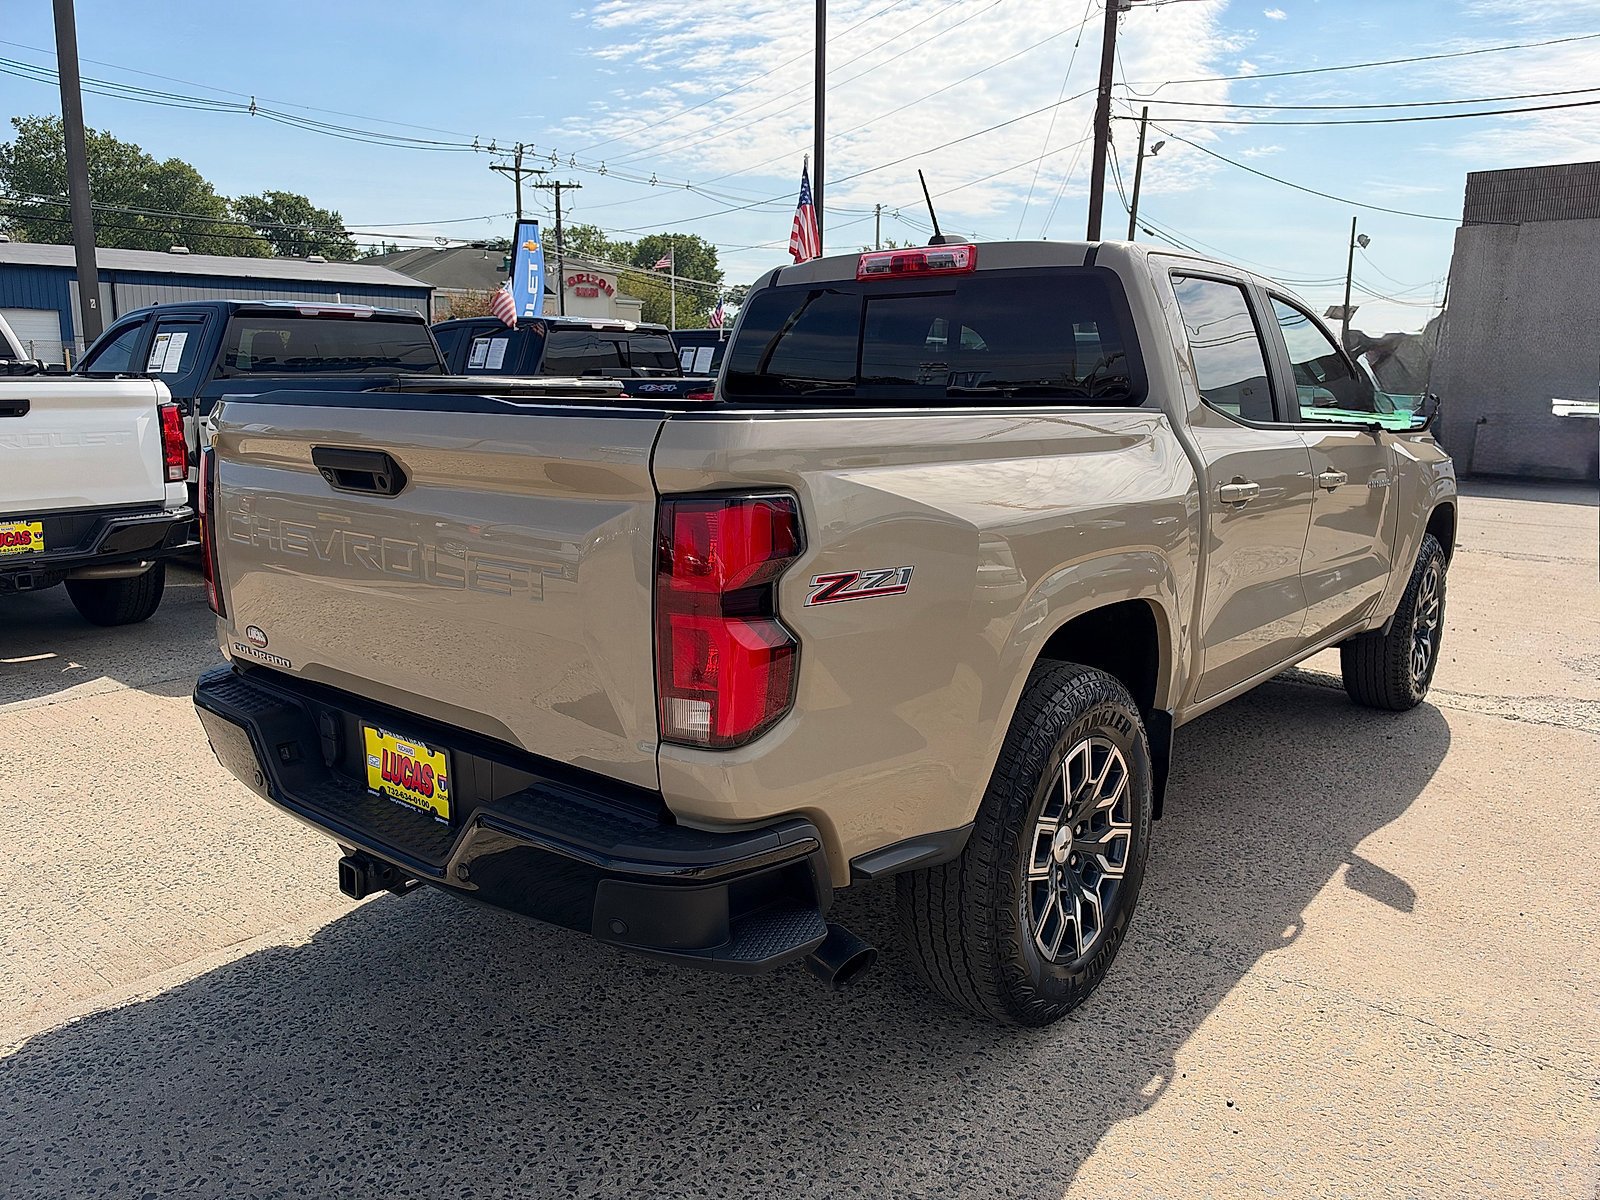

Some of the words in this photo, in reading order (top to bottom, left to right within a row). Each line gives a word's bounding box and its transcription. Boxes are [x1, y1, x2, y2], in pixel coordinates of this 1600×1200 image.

[567, 273, 615, 297] ORIZON
[226, 508, 566, 602] CHEVROLET
[803, 566, 915, 607] Z71
[233, 642, 292, 668] COLORADO
[1058, 706, 1133, 757] WRANGLER
[381, 748, 435, 798] LUCAS
[386, 785, 430, 808] 732-634-0100
